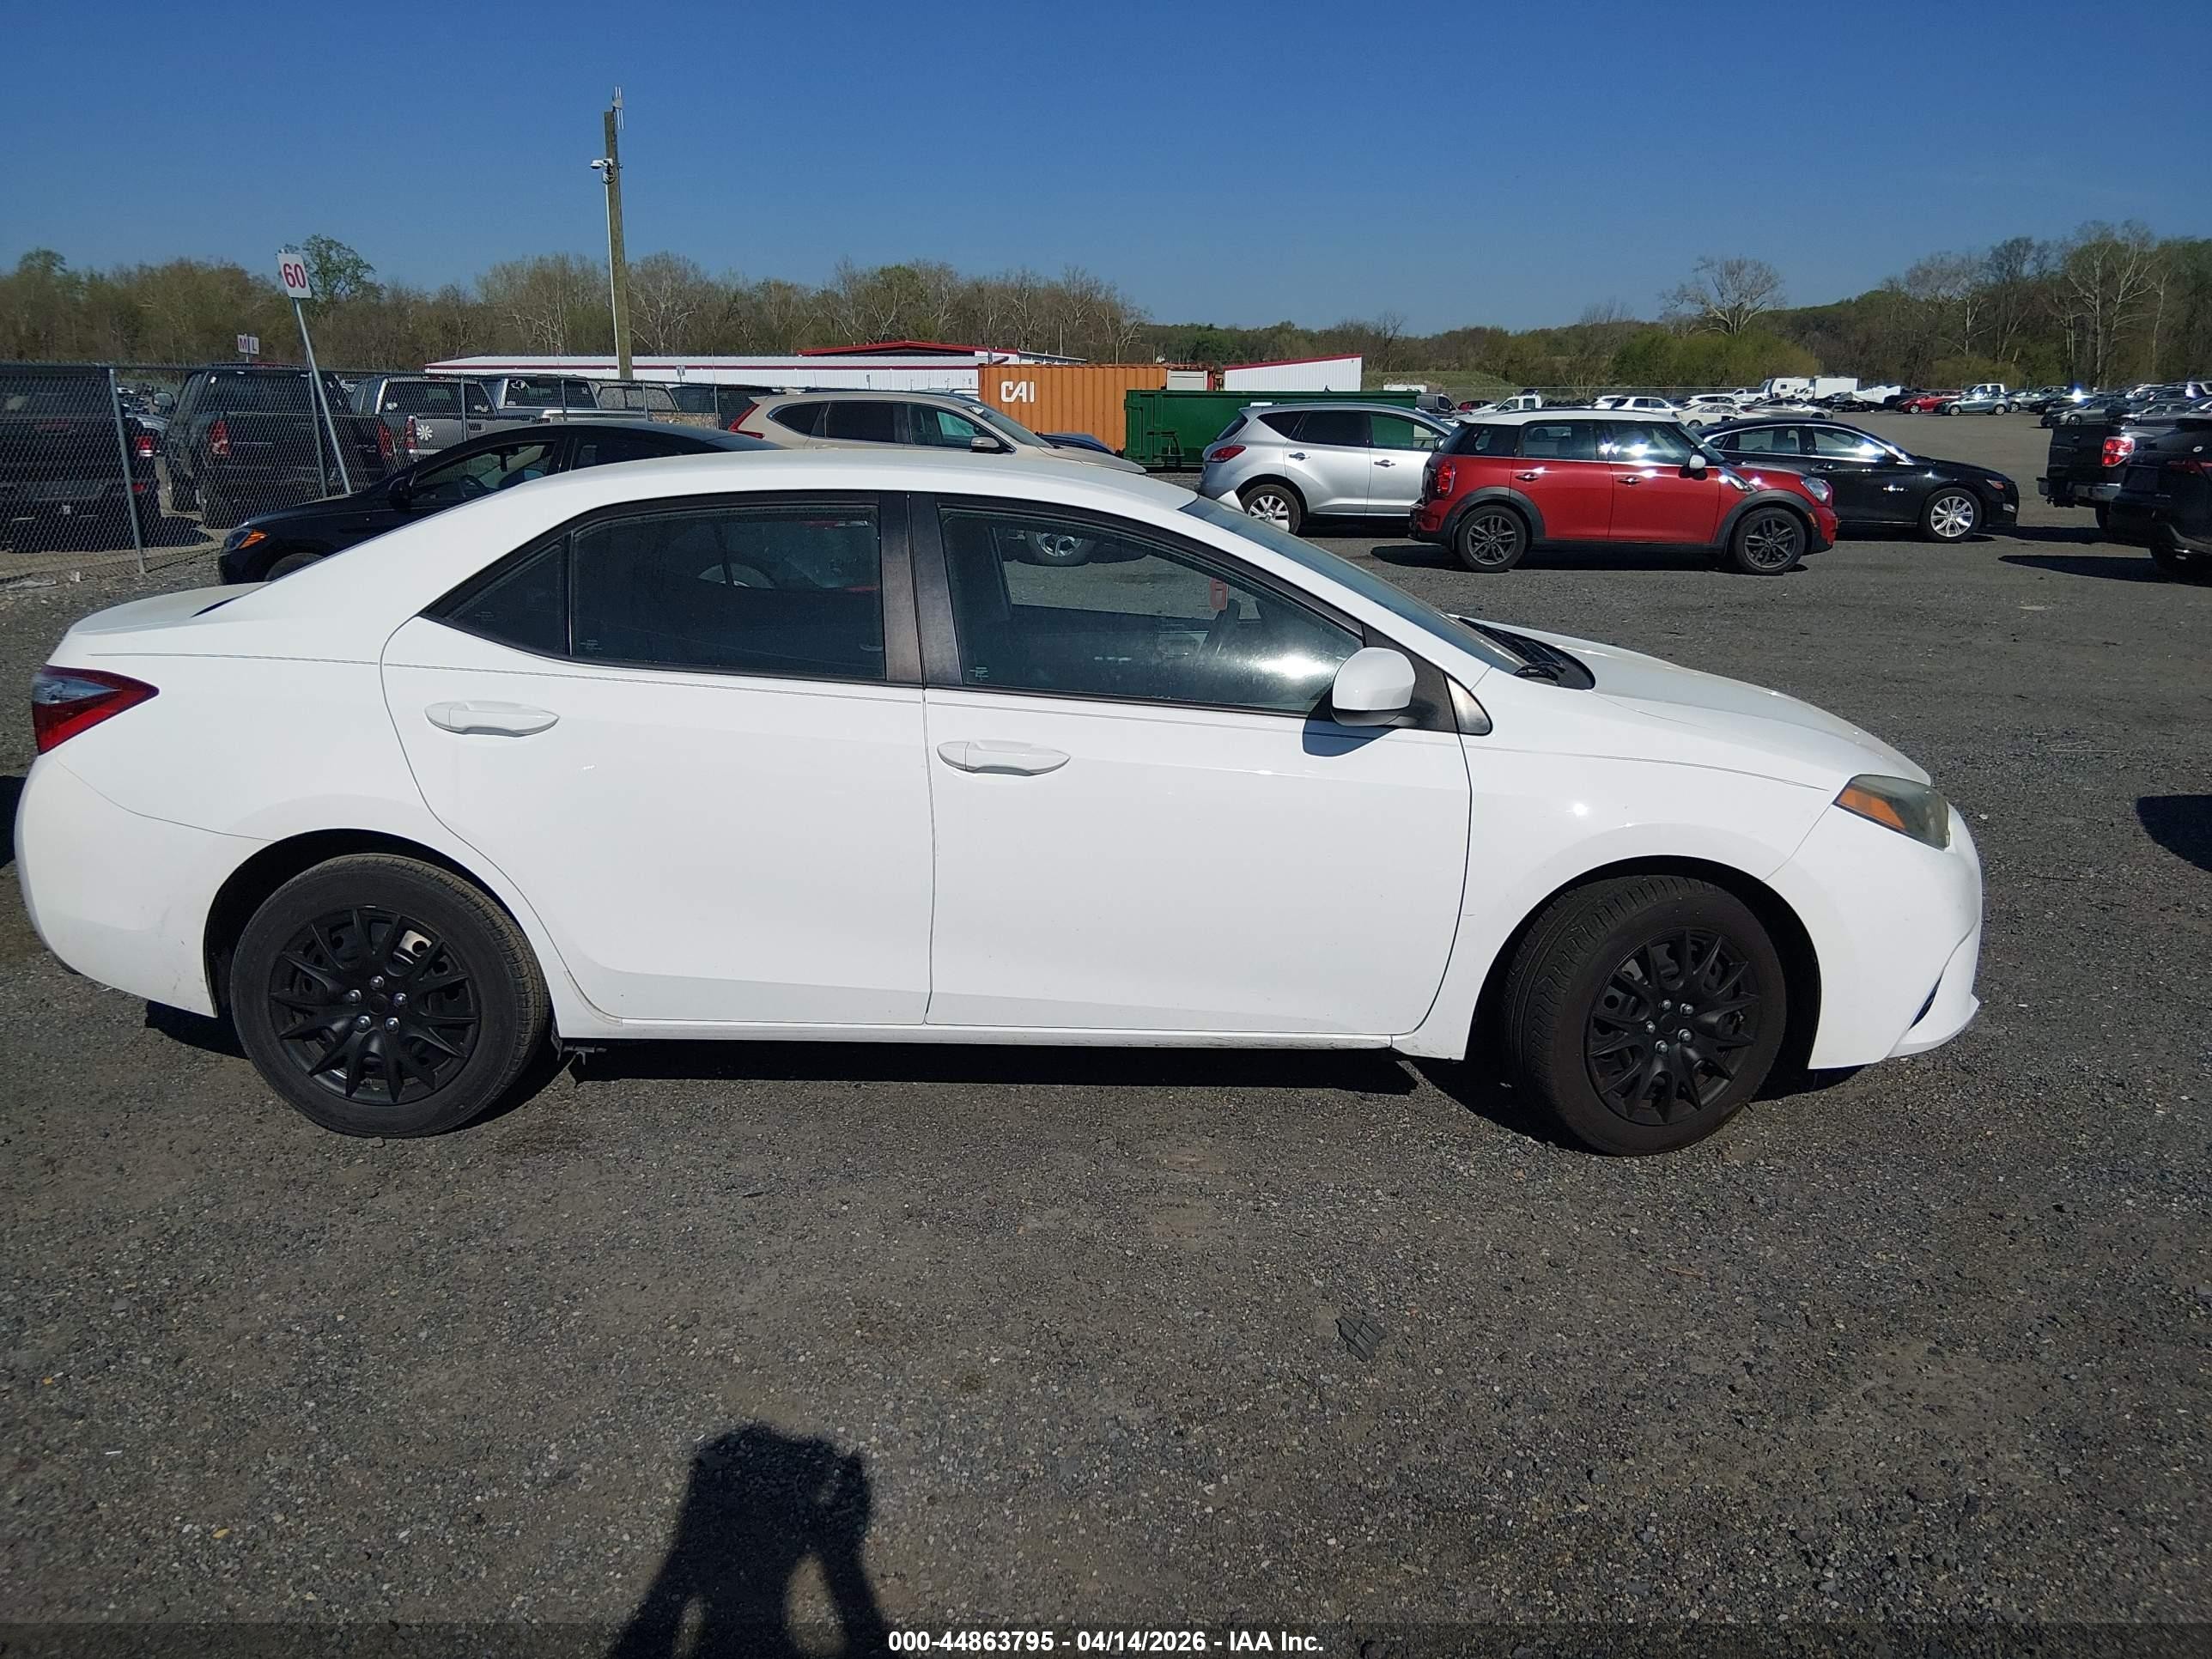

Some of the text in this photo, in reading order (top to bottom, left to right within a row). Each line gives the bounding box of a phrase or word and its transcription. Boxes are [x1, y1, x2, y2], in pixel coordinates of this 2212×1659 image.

[283, 263, 306, 289] 60
[240, 337, 248, 350] M
[1000, 380, 1035, 403] CAI
